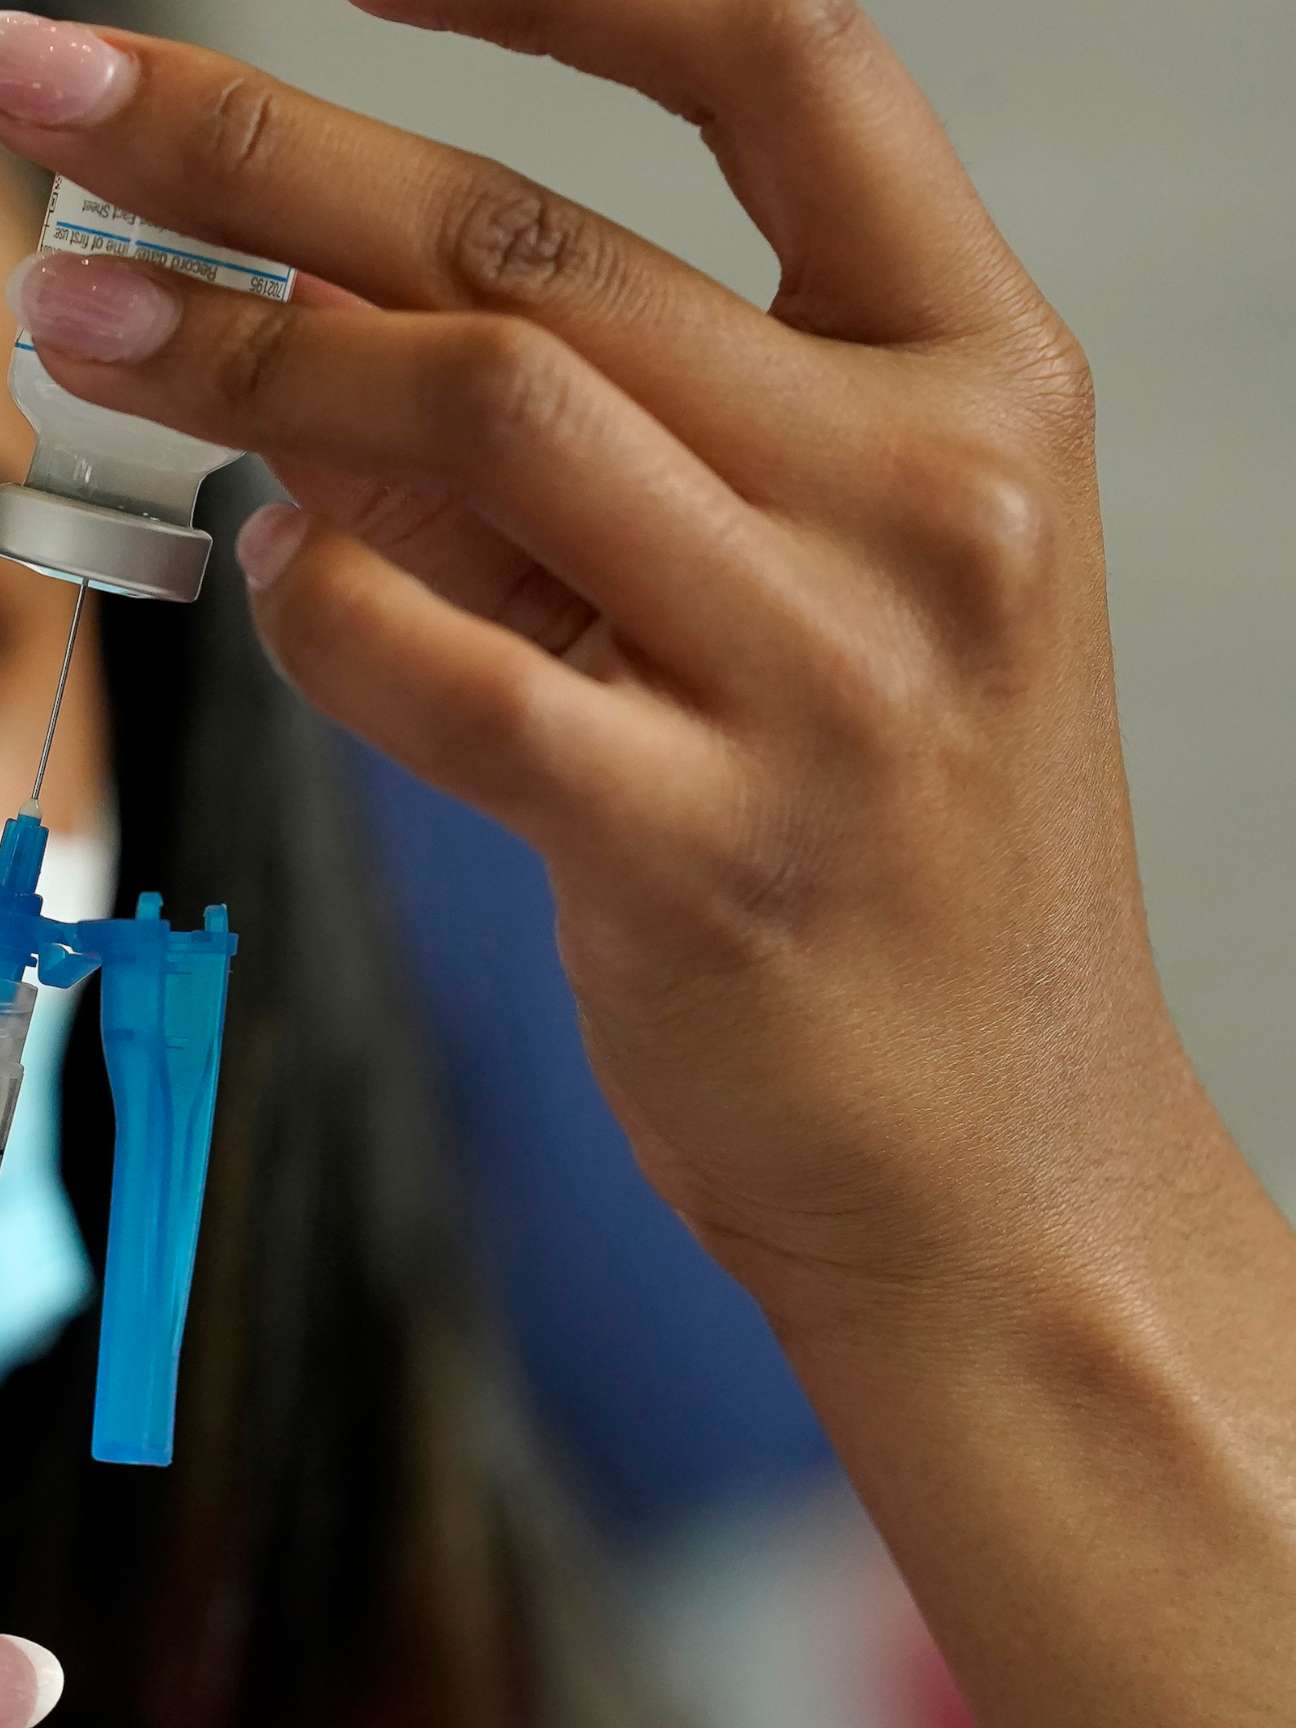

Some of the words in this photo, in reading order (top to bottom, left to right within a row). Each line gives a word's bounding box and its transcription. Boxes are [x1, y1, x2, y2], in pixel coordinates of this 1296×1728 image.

[82, 200, 111, 219] Sheet
[54, 227, 70, 241] use
[70, 229, 90, 249] first
[91, 235, 104, 251] of
[170, 256, 218, 281] Record
[248, 276, 283, 298] 702195
